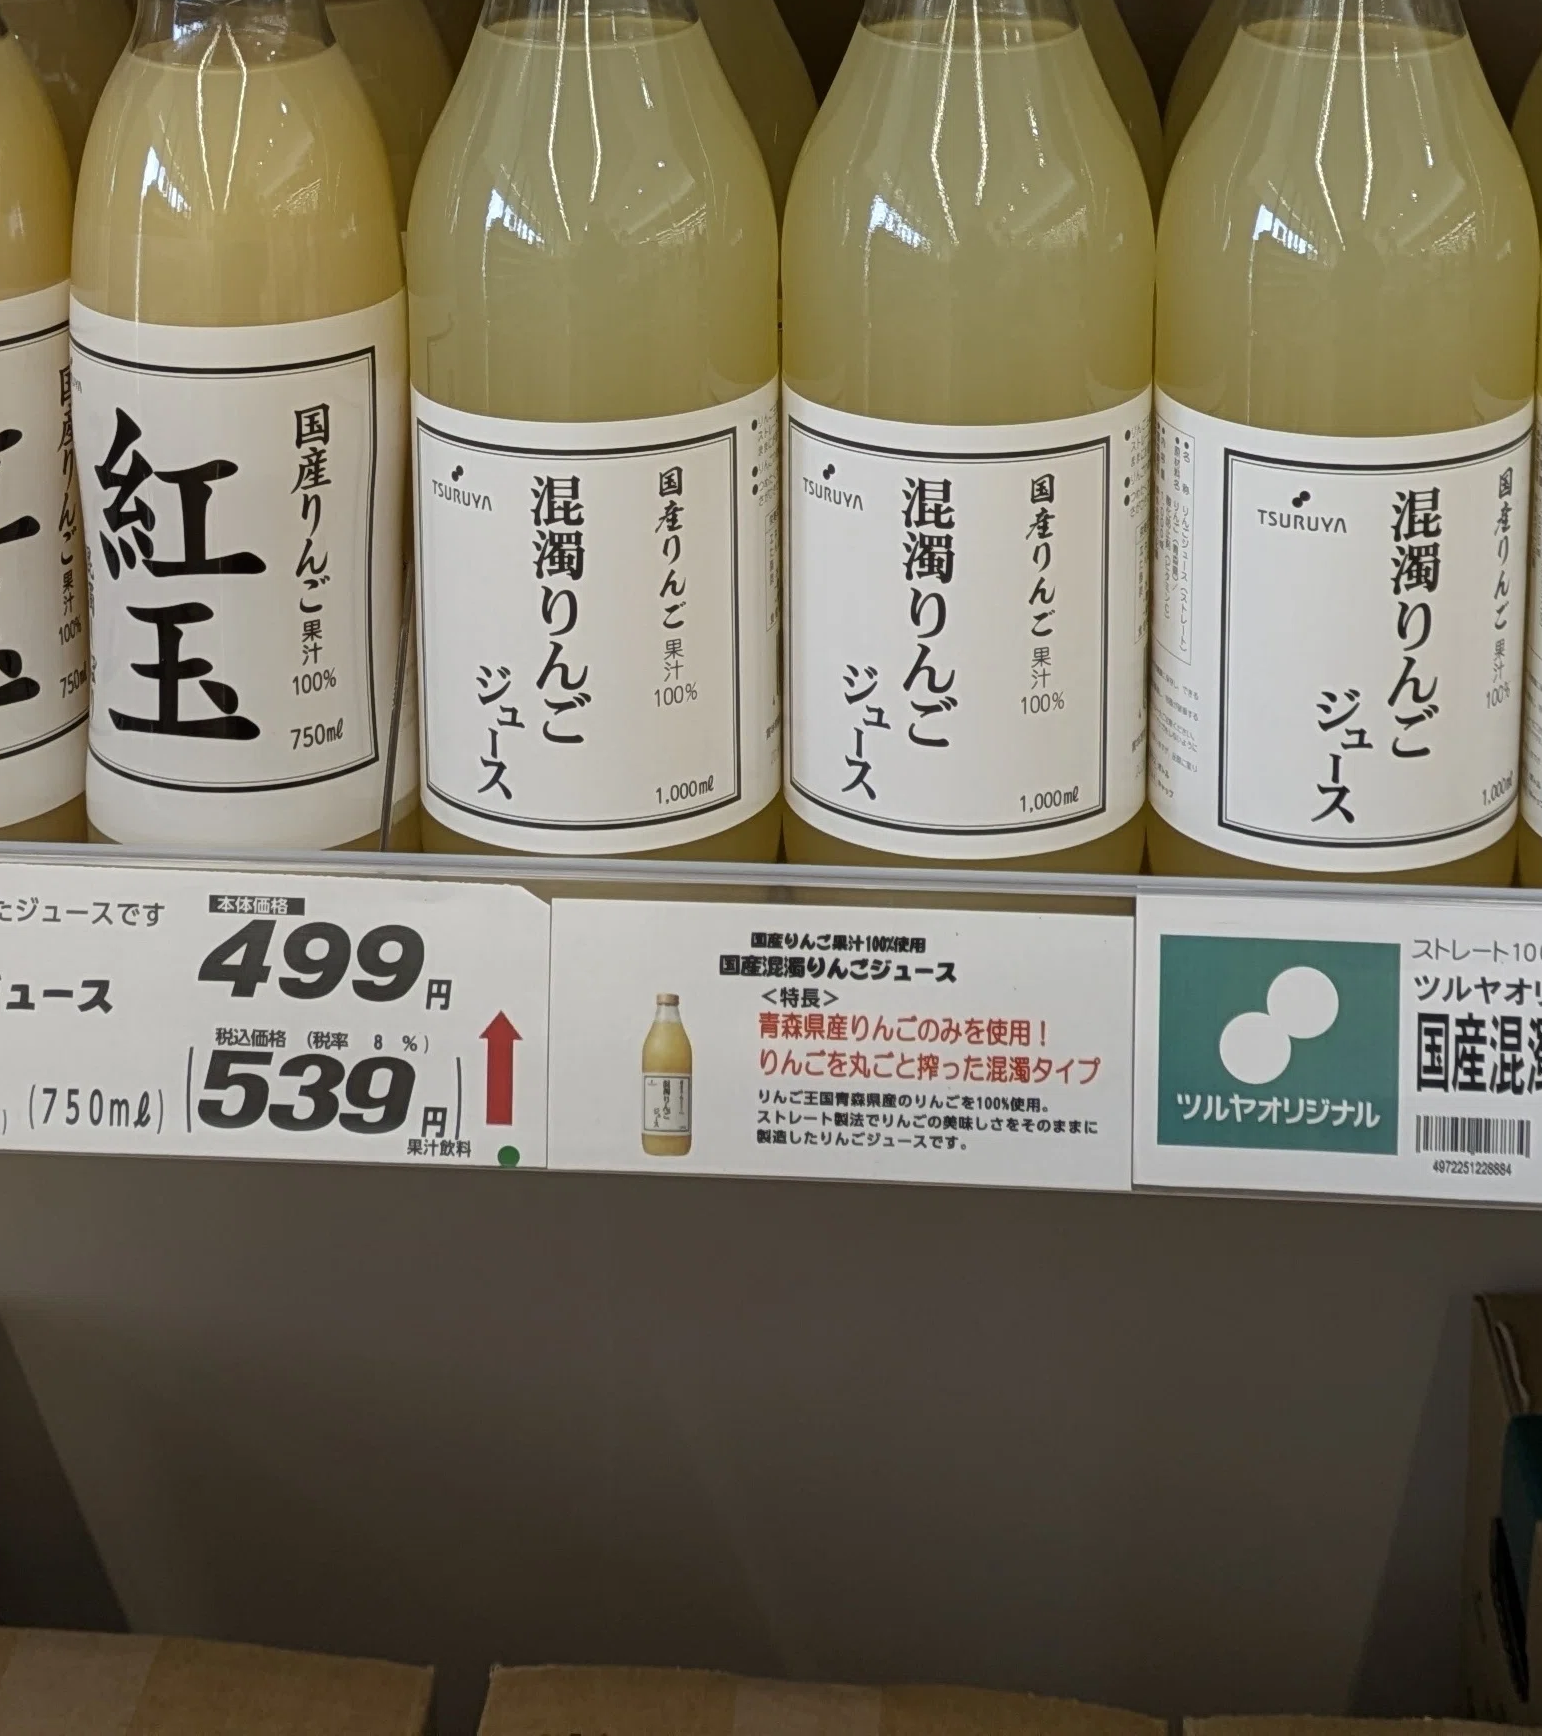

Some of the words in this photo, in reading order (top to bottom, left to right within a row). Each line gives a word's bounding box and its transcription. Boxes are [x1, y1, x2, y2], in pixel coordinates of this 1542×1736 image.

[432, 479, 493, 512] TSURUYA
[803, 476, 863, 511] TSURUYA
[1257, 509, 1347, 534] TSURUYA
[93, 407, 266, 741] 紅玉
[531, 475, 590, 744] 混濁りんご
[902, 478, 958, 748] 混濁りんご
[1387, 487, 1441, 759] 混濁りんご
[477, 665, 525, 800] ジュース
[842, 665, 891, 801] ジュース
[1311, 688, 1373, 824] ジュース
[217, 897, 288, 914] 本体価格
[751, 932, 926, 953] 国産りんご果汁100%使用
[720, 954, 956, 982] 国産混濁りんごジュース
[215, 1028, 286, 1047] 税込価格
[758, 1013, 1048, 1046] 青森県産りんごのみを使用！
[758, 1050, 1100, 1084] りんごを丸ごと搾った混濁タイプ
[758, 1110, 1098, 1134] ストレート製法でりんごの美味しさをそのままに
[1176, 1093, 1380, 1128] ツルヤオリジナル
[407, 1139, 471, 1158] 果汁飲料
[757, 1130, 968, 1150] 製造したりんごジュースです。
